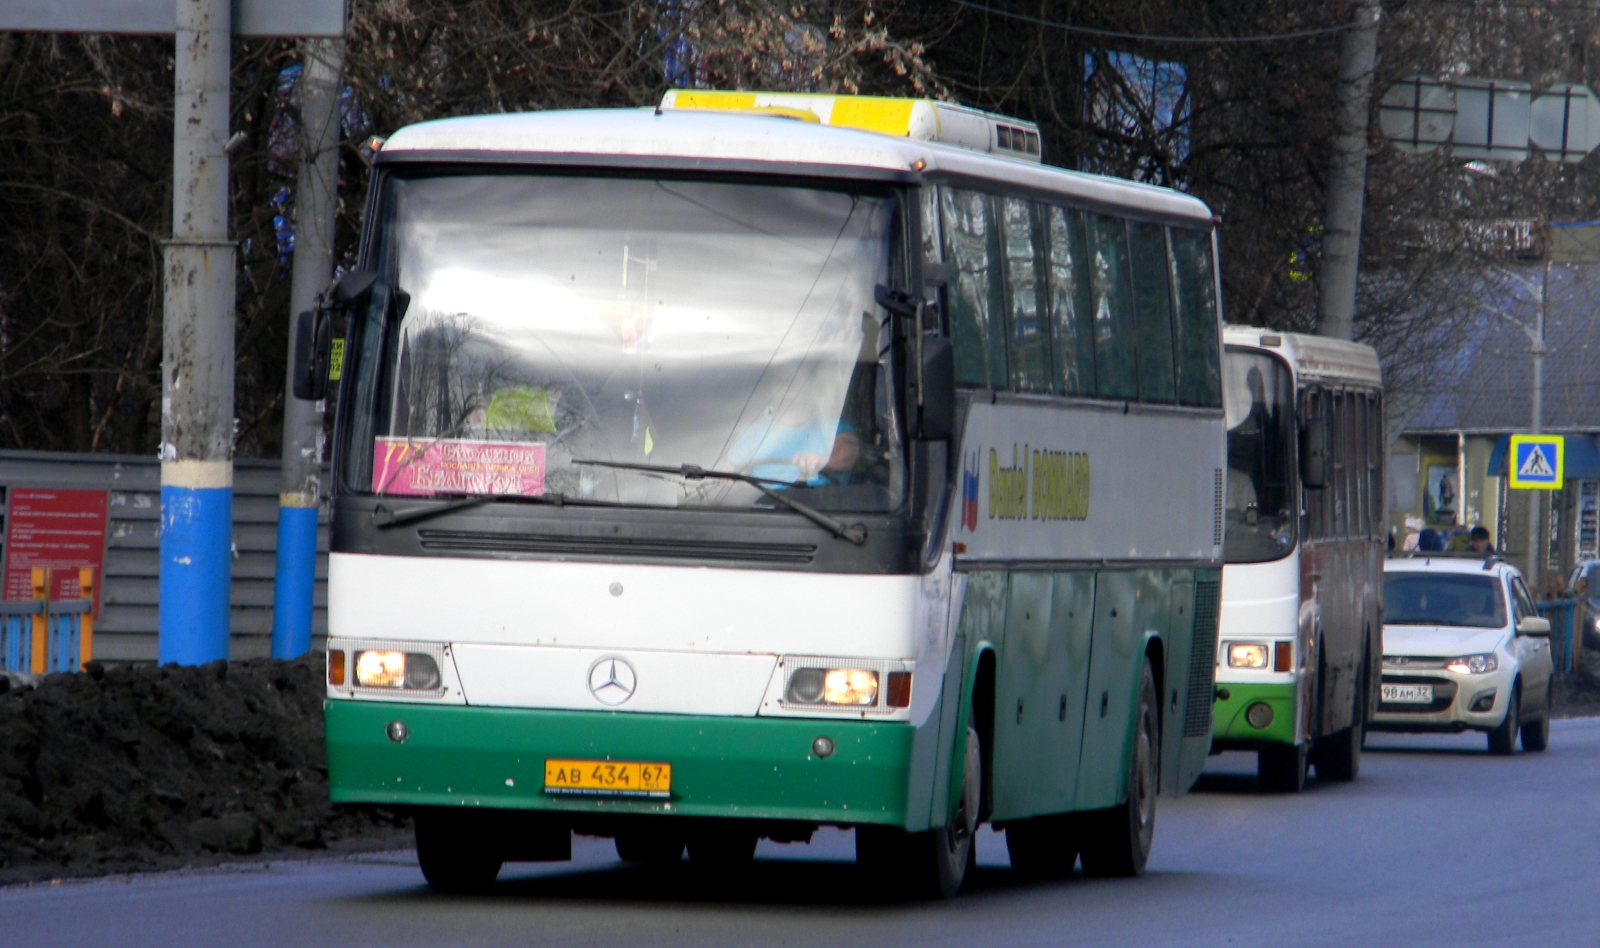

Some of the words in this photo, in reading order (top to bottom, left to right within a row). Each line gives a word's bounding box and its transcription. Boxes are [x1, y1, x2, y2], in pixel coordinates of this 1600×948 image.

[384, 442, 423, 463] 777
[439, 443, 534, 464] СМОЛЕНСК
[988, 442, 1029, 520] Daniel
[1416, 686, 1428, 697] 32
[591, 765, 630, 786] 434
[642, 766, 663, 782] 67
